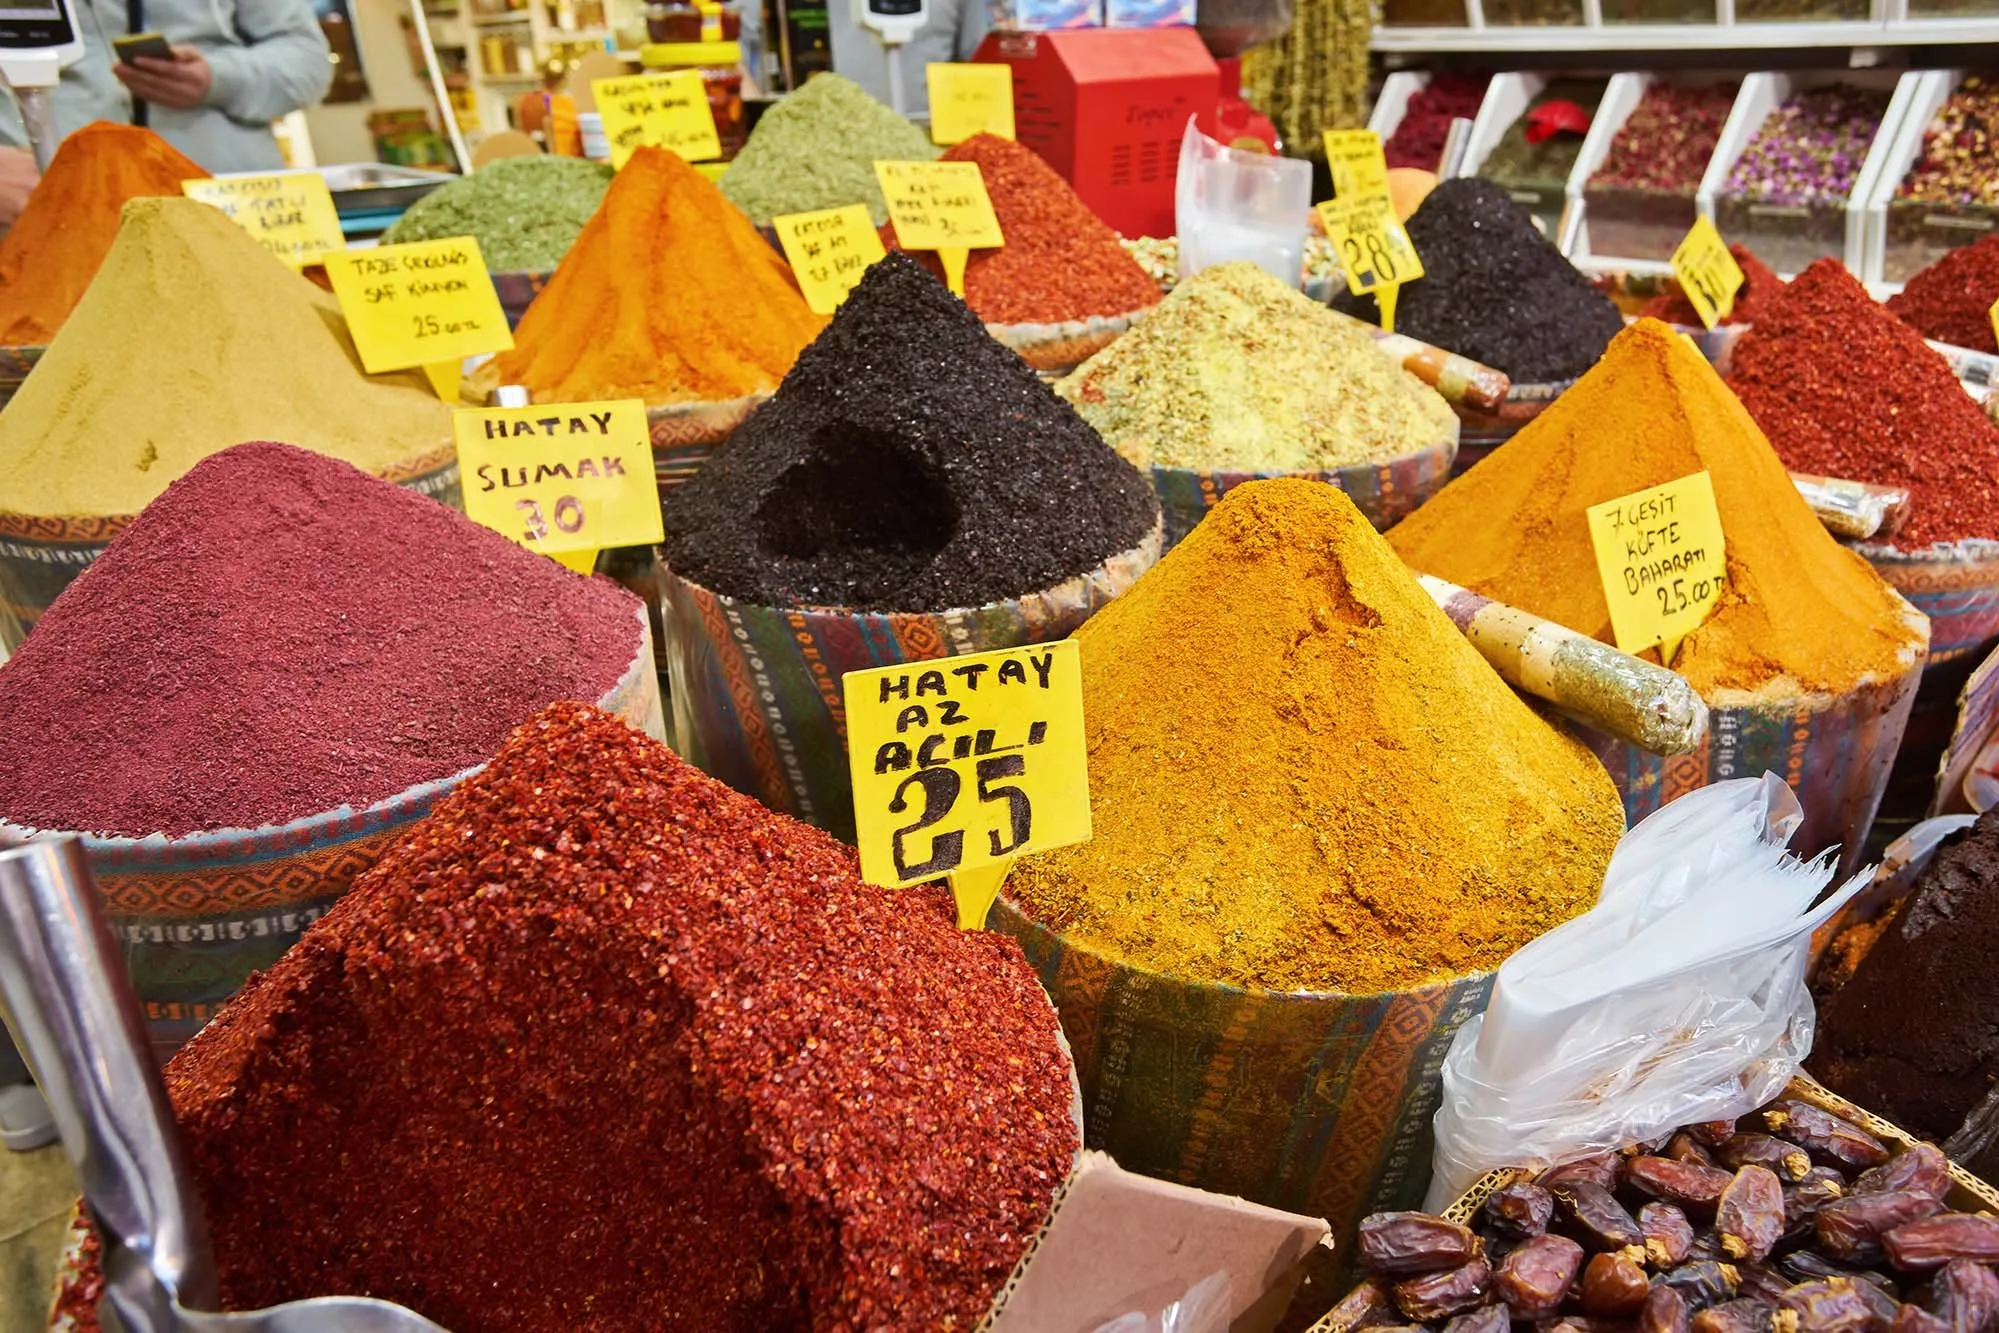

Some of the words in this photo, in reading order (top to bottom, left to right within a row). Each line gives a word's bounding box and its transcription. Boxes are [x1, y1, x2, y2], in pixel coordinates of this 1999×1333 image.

[350, 257, 398, 277] TAZE
[364, 283, 397, 304] SAF
[485, 411, 612, 440] HATAY
[477, 456, 627, 493] SUMAK
[515, 495, 585, 542] 30
[1623, 547, 1706, 596] BAHARATI
[880, 652, 1053, 704] HATAY
[896, 700, 970, 734] AZ
[888, 754, 1032, 881] 25
